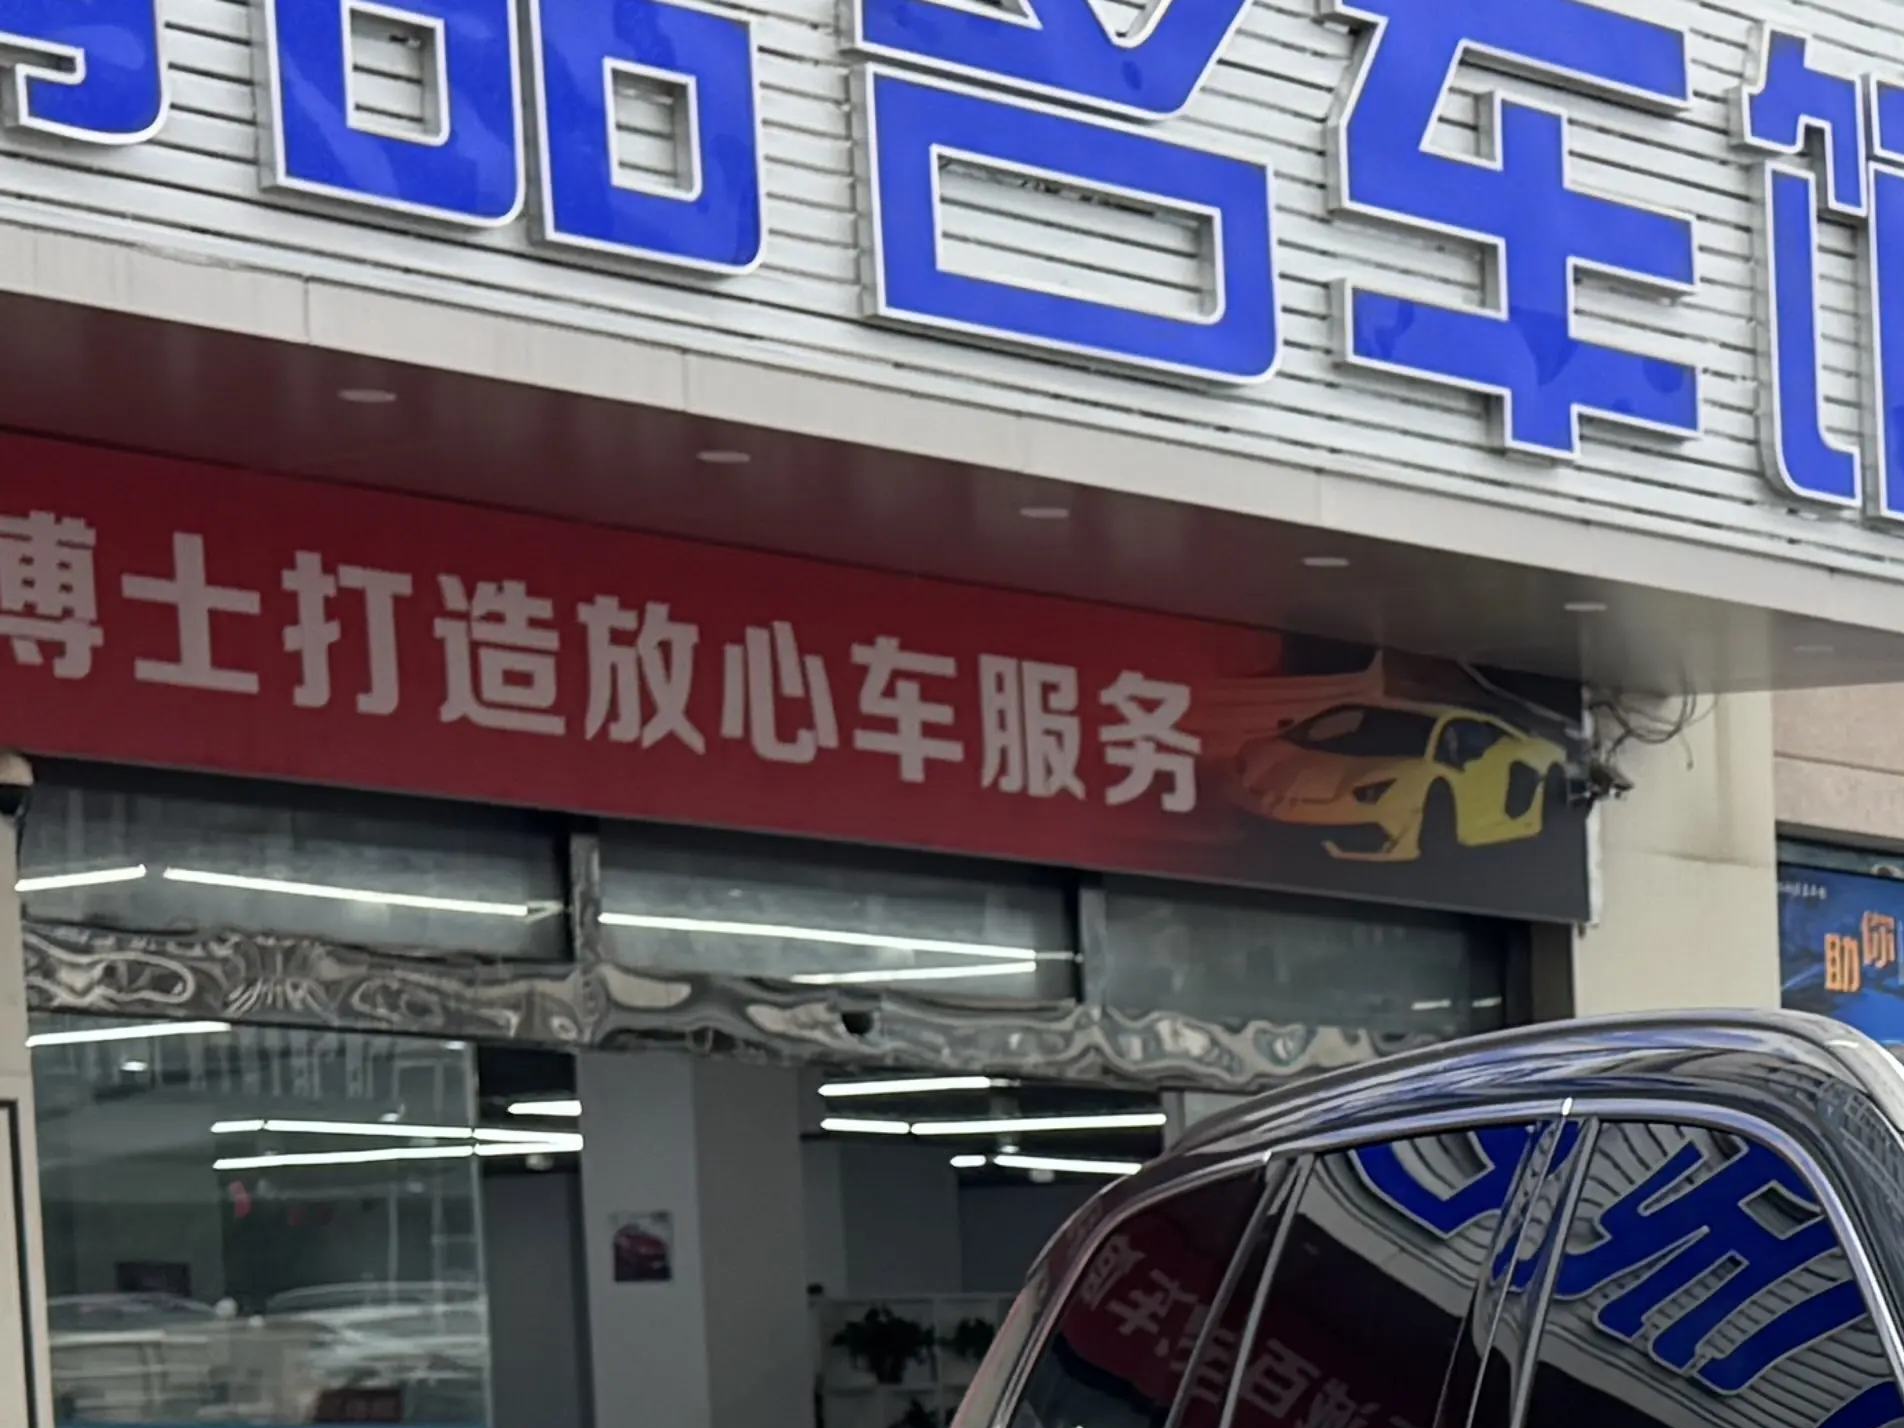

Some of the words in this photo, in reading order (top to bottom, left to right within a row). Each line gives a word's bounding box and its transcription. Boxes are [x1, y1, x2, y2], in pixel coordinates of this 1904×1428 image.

[0, 510, 1201, 812] 博士打造放心车服务
